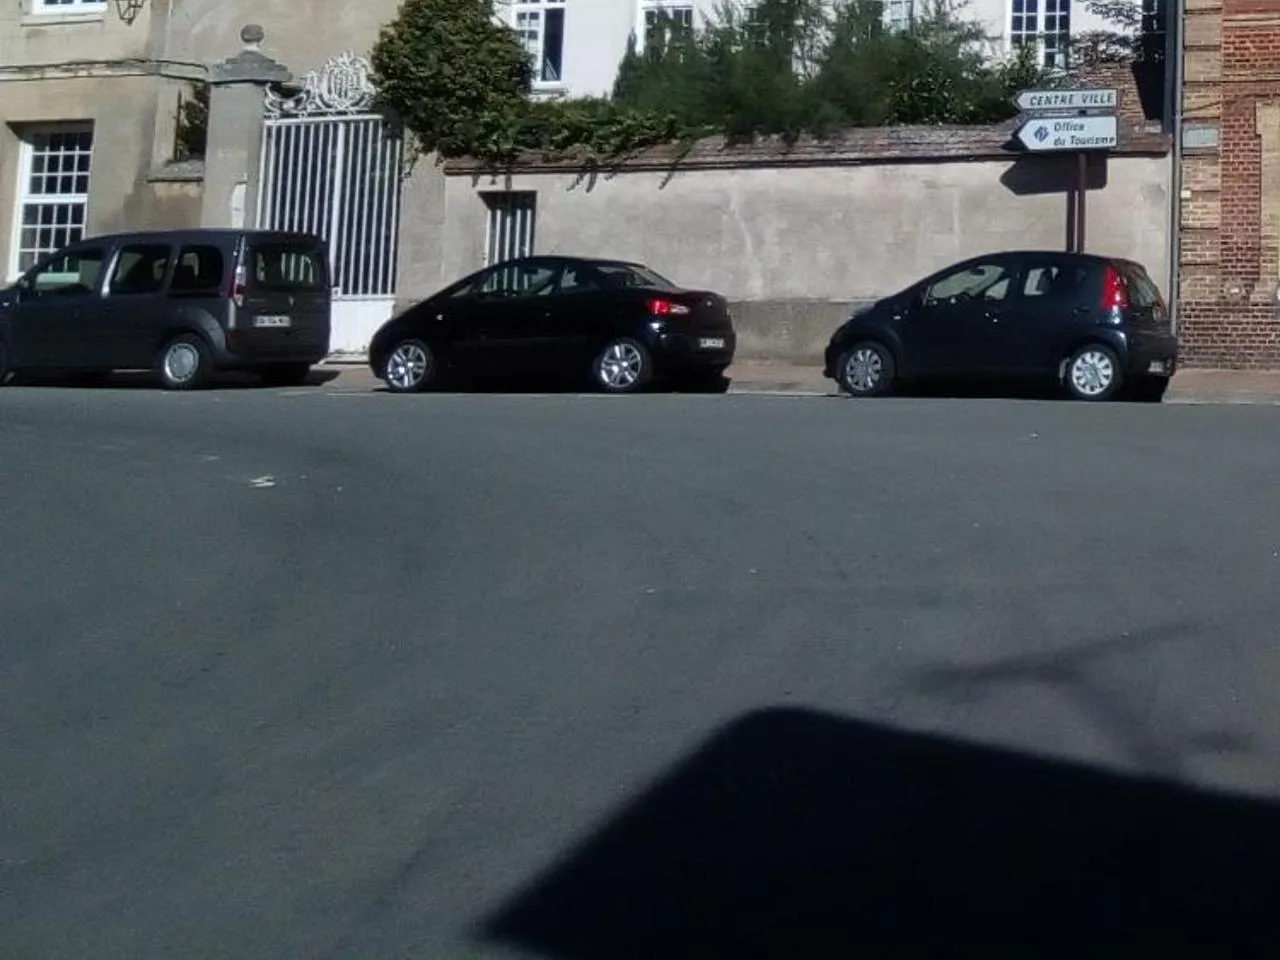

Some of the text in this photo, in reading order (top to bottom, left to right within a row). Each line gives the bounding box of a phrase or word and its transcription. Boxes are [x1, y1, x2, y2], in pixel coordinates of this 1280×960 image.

[1029, 92, 1113, 106] CENTRE VILLE
[1054, 122, 1085, 132] Office
[1053, 135, 1115, 146] du Tourisme
